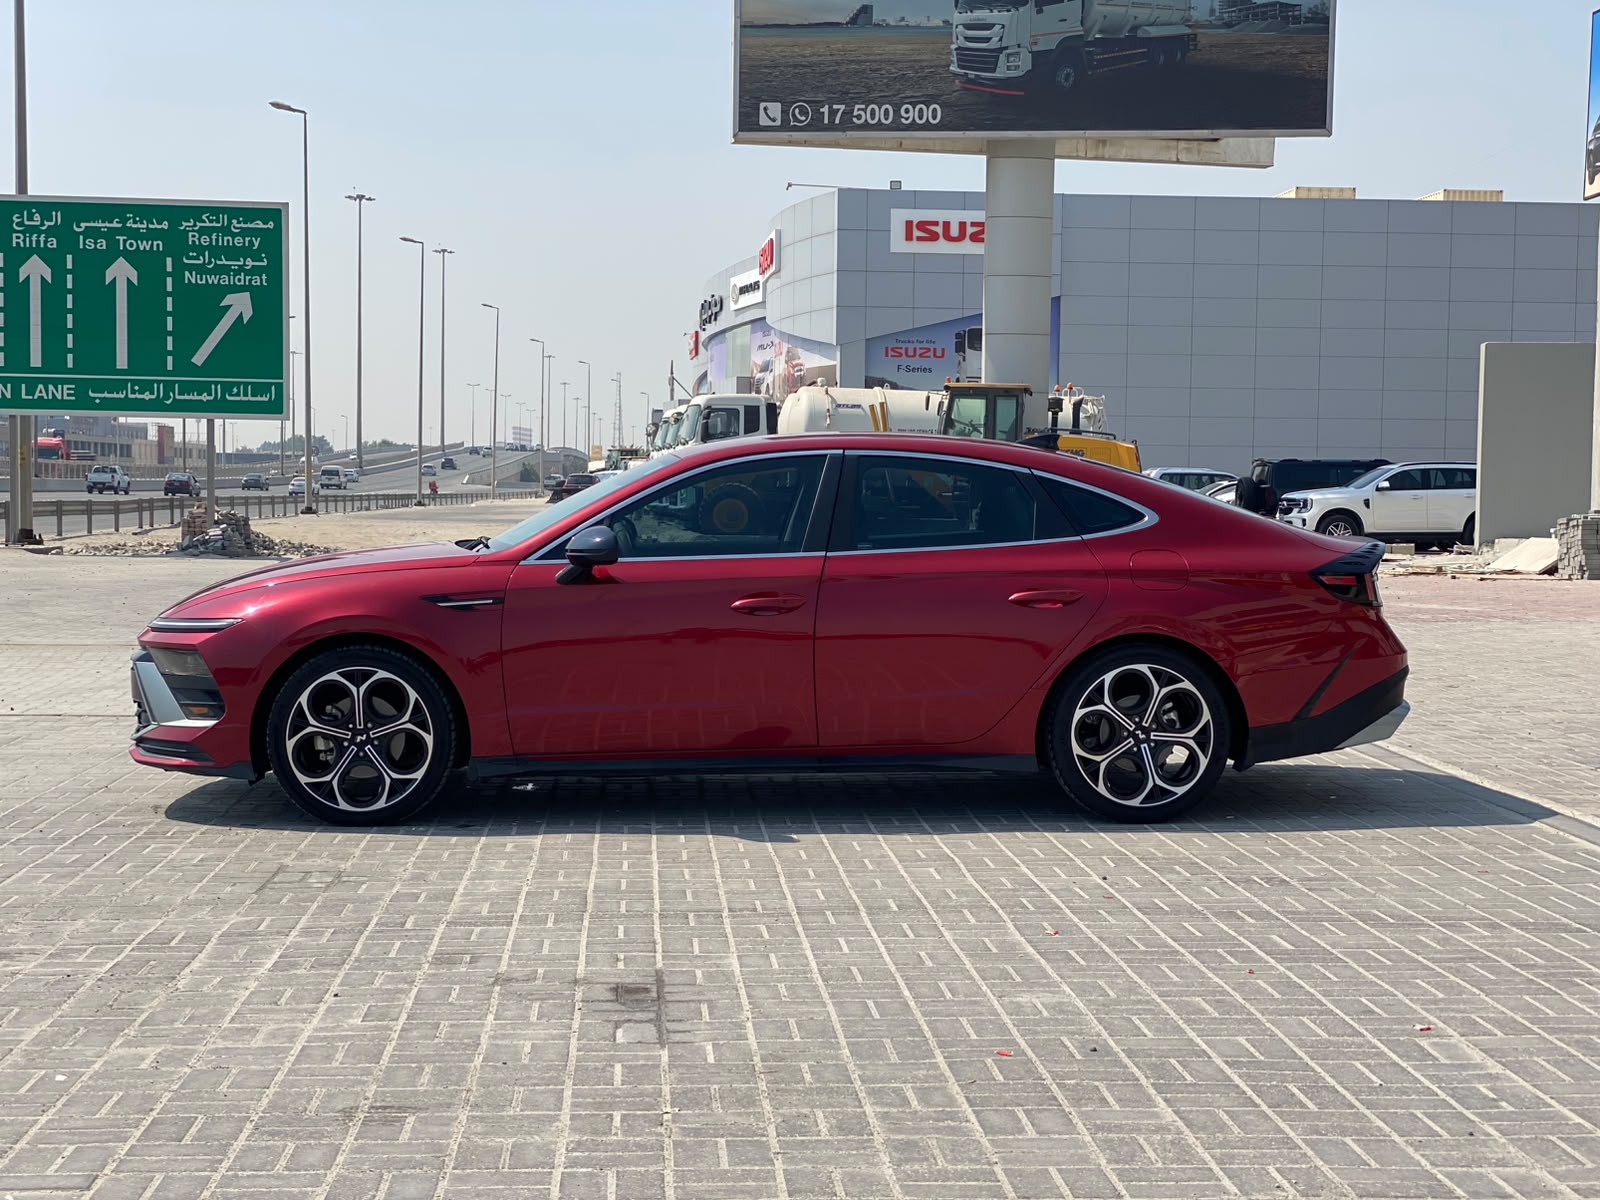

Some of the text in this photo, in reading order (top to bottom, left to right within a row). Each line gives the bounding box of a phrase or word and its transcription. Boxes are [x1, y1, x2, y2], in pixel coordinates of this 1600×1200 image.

[819, 104, 941, 124] 17 500 900
[12, 208, 61, 230] الرفاع
[73, 213, 169, 233] مدينة عيسى
[178, 212, 274, 233] مصنع التكرير
[188, 231, 261, 249] Refinery
[905, 219, 985, 243] ISUZ
[12, 232, 57, 249] Riffa
[79, 234, 163, 251] Isa Town
[182, 250, 268, 269] نويدرات
[184, 270, 268, 286] Nuwaidrat
[884, 346, 946, 359] ISUZU
[897, 364, 933, 374] F-Series
[21, 383, 76, 400] LANE
[88, 382, 275, 404] اسلك المسار المناسب
